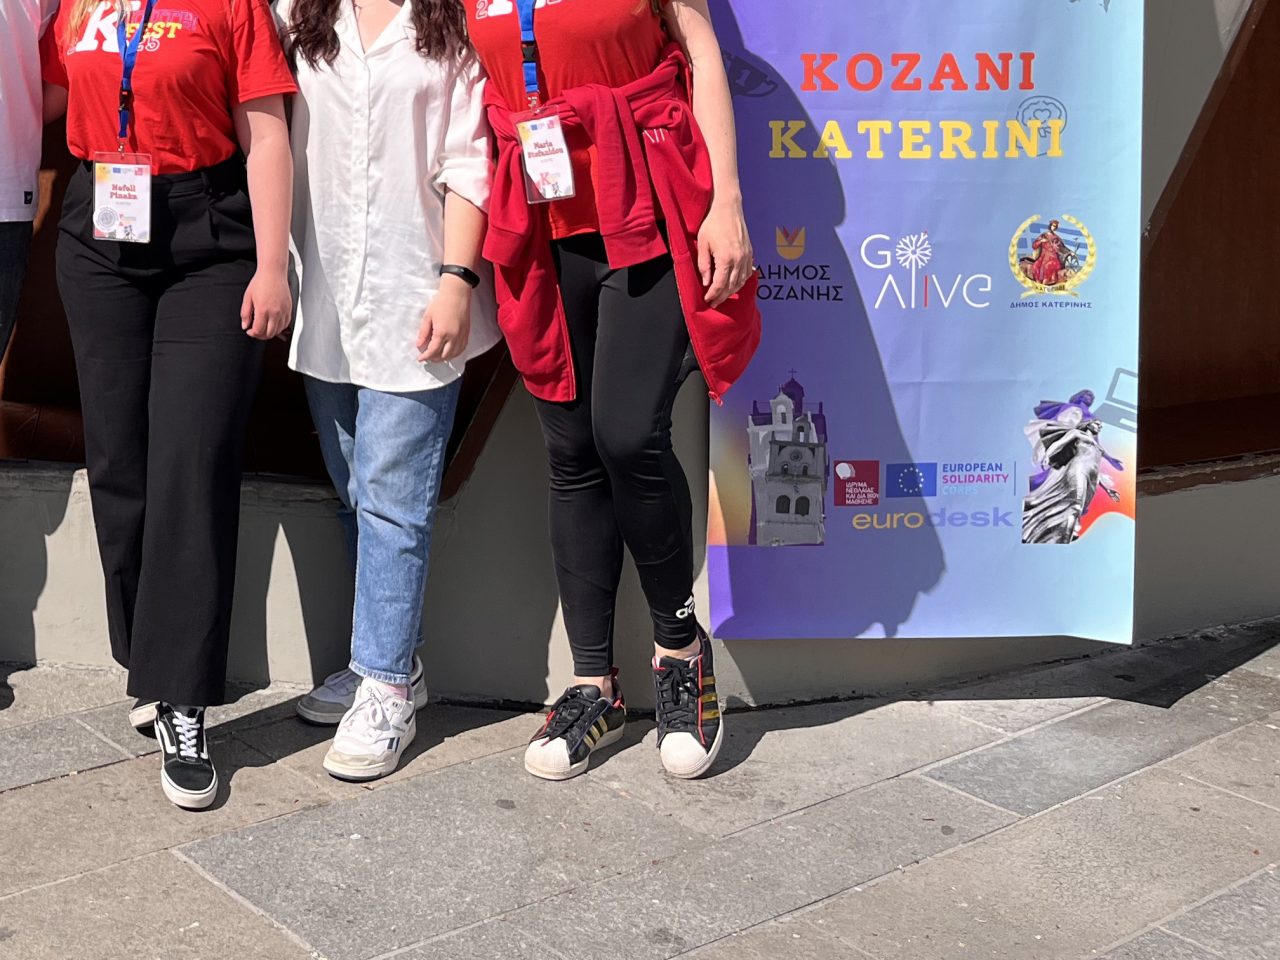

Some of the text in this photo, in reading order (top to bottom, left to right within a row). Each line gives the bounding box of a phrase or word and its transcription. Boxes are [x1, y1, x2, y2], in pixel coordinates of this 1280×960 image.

[800, 52, 1036, 92] KOZANI
[768, 119, 1065, 160] KATERINI
[756, 264, 830, 280] ΔΗΜΟΣ
[756, 284, 843, 301] ΟΖΑΝΗΣ
[942, 462, 1003, 473] EUROPEAN
[942, 473, 1009, 484] SOLIDARITY
[851, 507, 1013, 530] eurodesk
